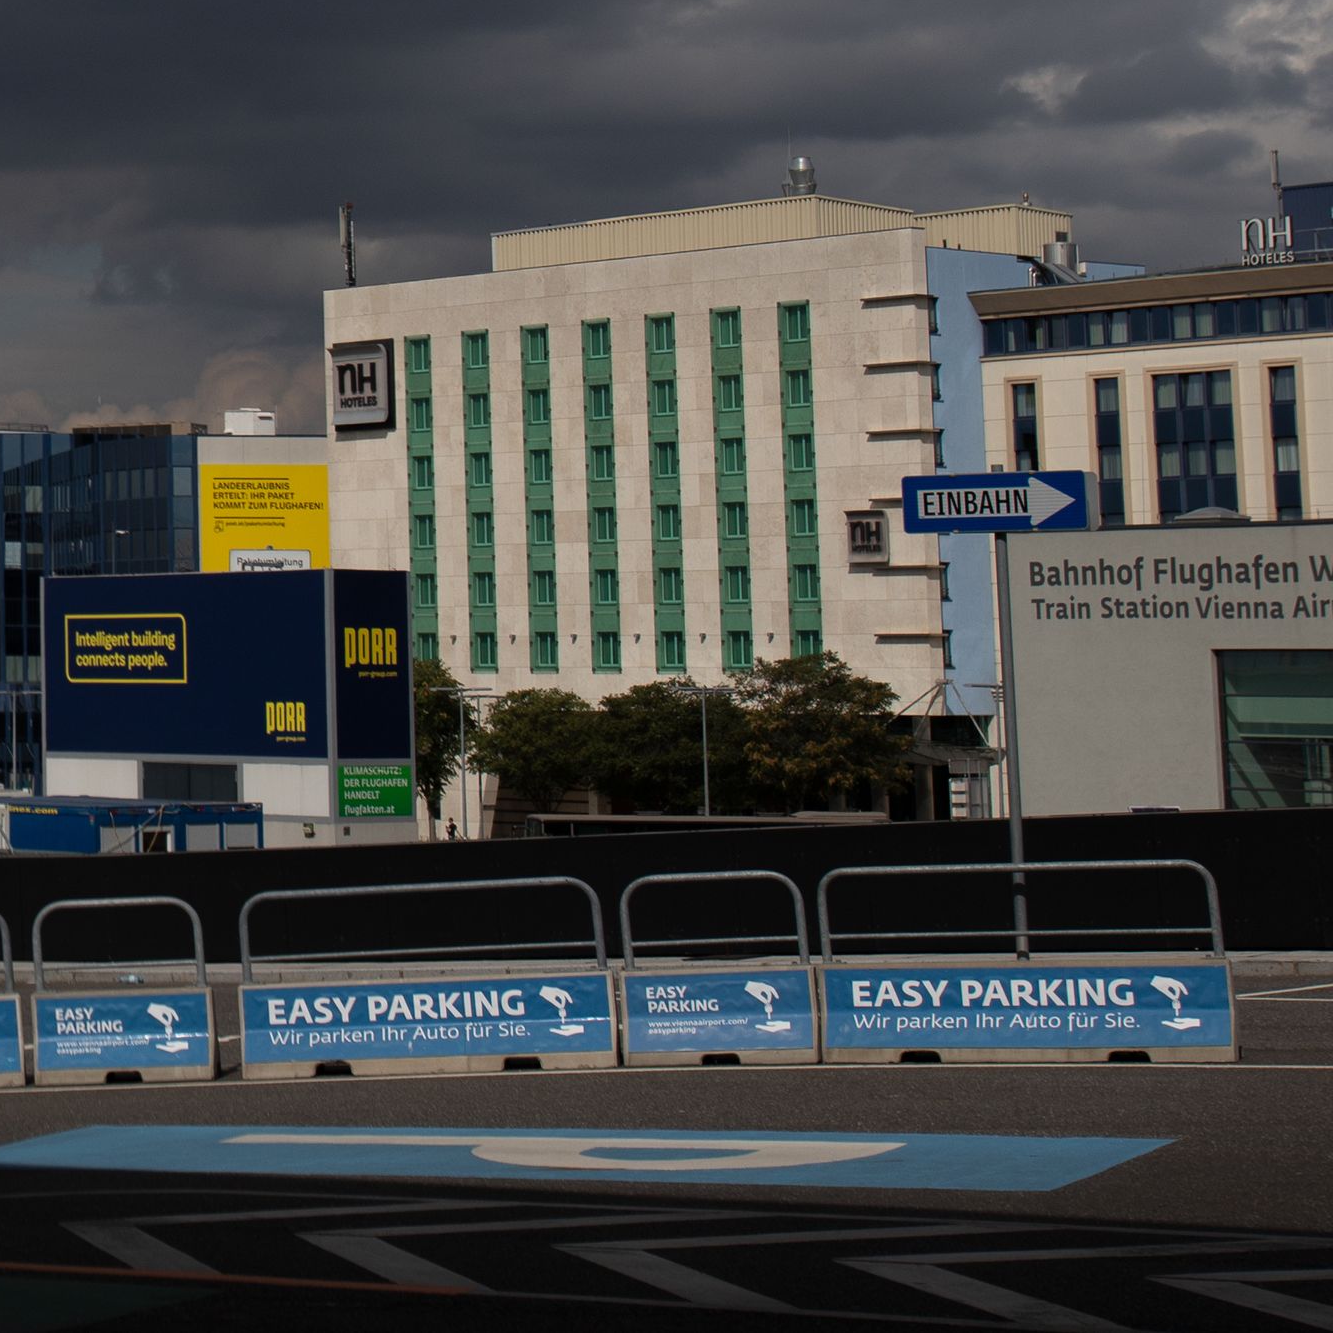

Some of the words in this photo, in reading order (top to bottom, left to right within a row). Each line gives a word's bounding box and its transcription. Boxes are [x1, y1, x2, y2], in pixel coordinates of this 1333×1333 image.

[1241, 251, 1295, 267] HOTELES
[340, 396, 377, 408] HOTELES
[213, 481, 290, 491] LANDEERLAUBNIS
[213, 491, 247, 500] ERTEILT:
[250, 491, 265, 500] IHR
[268, 491, 295, 500] PAKET
[923, 489, 1028, 516] EINBAHN
[213, 501, 246, 510] KOMMT
[248, 501, 268, 510] ZUM
[270, 501, 324, 510] FLUGHAFEN!
[1029, 556, 1144, 591] Bahnhof
[1153, 555, 1299, 591] Flughafen
[1031, 595, 1091, 620] Train
[1101, 594, 1189, 619] Station
[1195, 594, 1284, 619] Vienna
[1292, 593, 1333, 618] Air
[75, 629, 130, 651] Intelligent
[131, 630, 176, 652] building
[75, 651, 126, 667] connects
[128, 651, 169, 671] people.
[343, 766, 403, 775] KLIMASCHUTZ:
[343, 778, 360, 787] DER
[361, 778, 408, 787] FLUGHAFEN
[343, 790, 380, 799] HANDELT
[344, 804, 396, 816] flugfakten.at
[646, 986, 687, 1000] EASY
[850, 979, 949, 1008] EASY
[960, 978, 1135, 1007] PARKING
[267, 996, 357, 1026] EASY
[367, 989, 525, 1022] PARKING
[648, 999, 719, 1014] PARKING
[55, 1007, 94, 1021] EASY
[57, 1020, 124, 1035] PARKING
[648, 1017, 749, 1028] www.viennaairport.com/
[853, 1012, 891, 1029] Wir
[896, 1012, 968, 1033] parken
[976, 1012, 1005, 1029] Ihr
[1009, 1013, 1062, 1029] Auto
[1068, 1012, 1099, 1033] für
[1105, 1012, 1141, 1029] Sie.
[269, 1030, 304, 1046] Wir
[309, 1027, 375, 1048] parken
[382, 1025, 408, 1042] Ihr
[412, 1025, 460, 1041] Auto
[465, 1022, 493, 1042] für
[498, 1022, 531, 1038] Sie.
[648, 1026, 696, 1036] easyparking
[57, 1047, 102, 1056] easyparking
